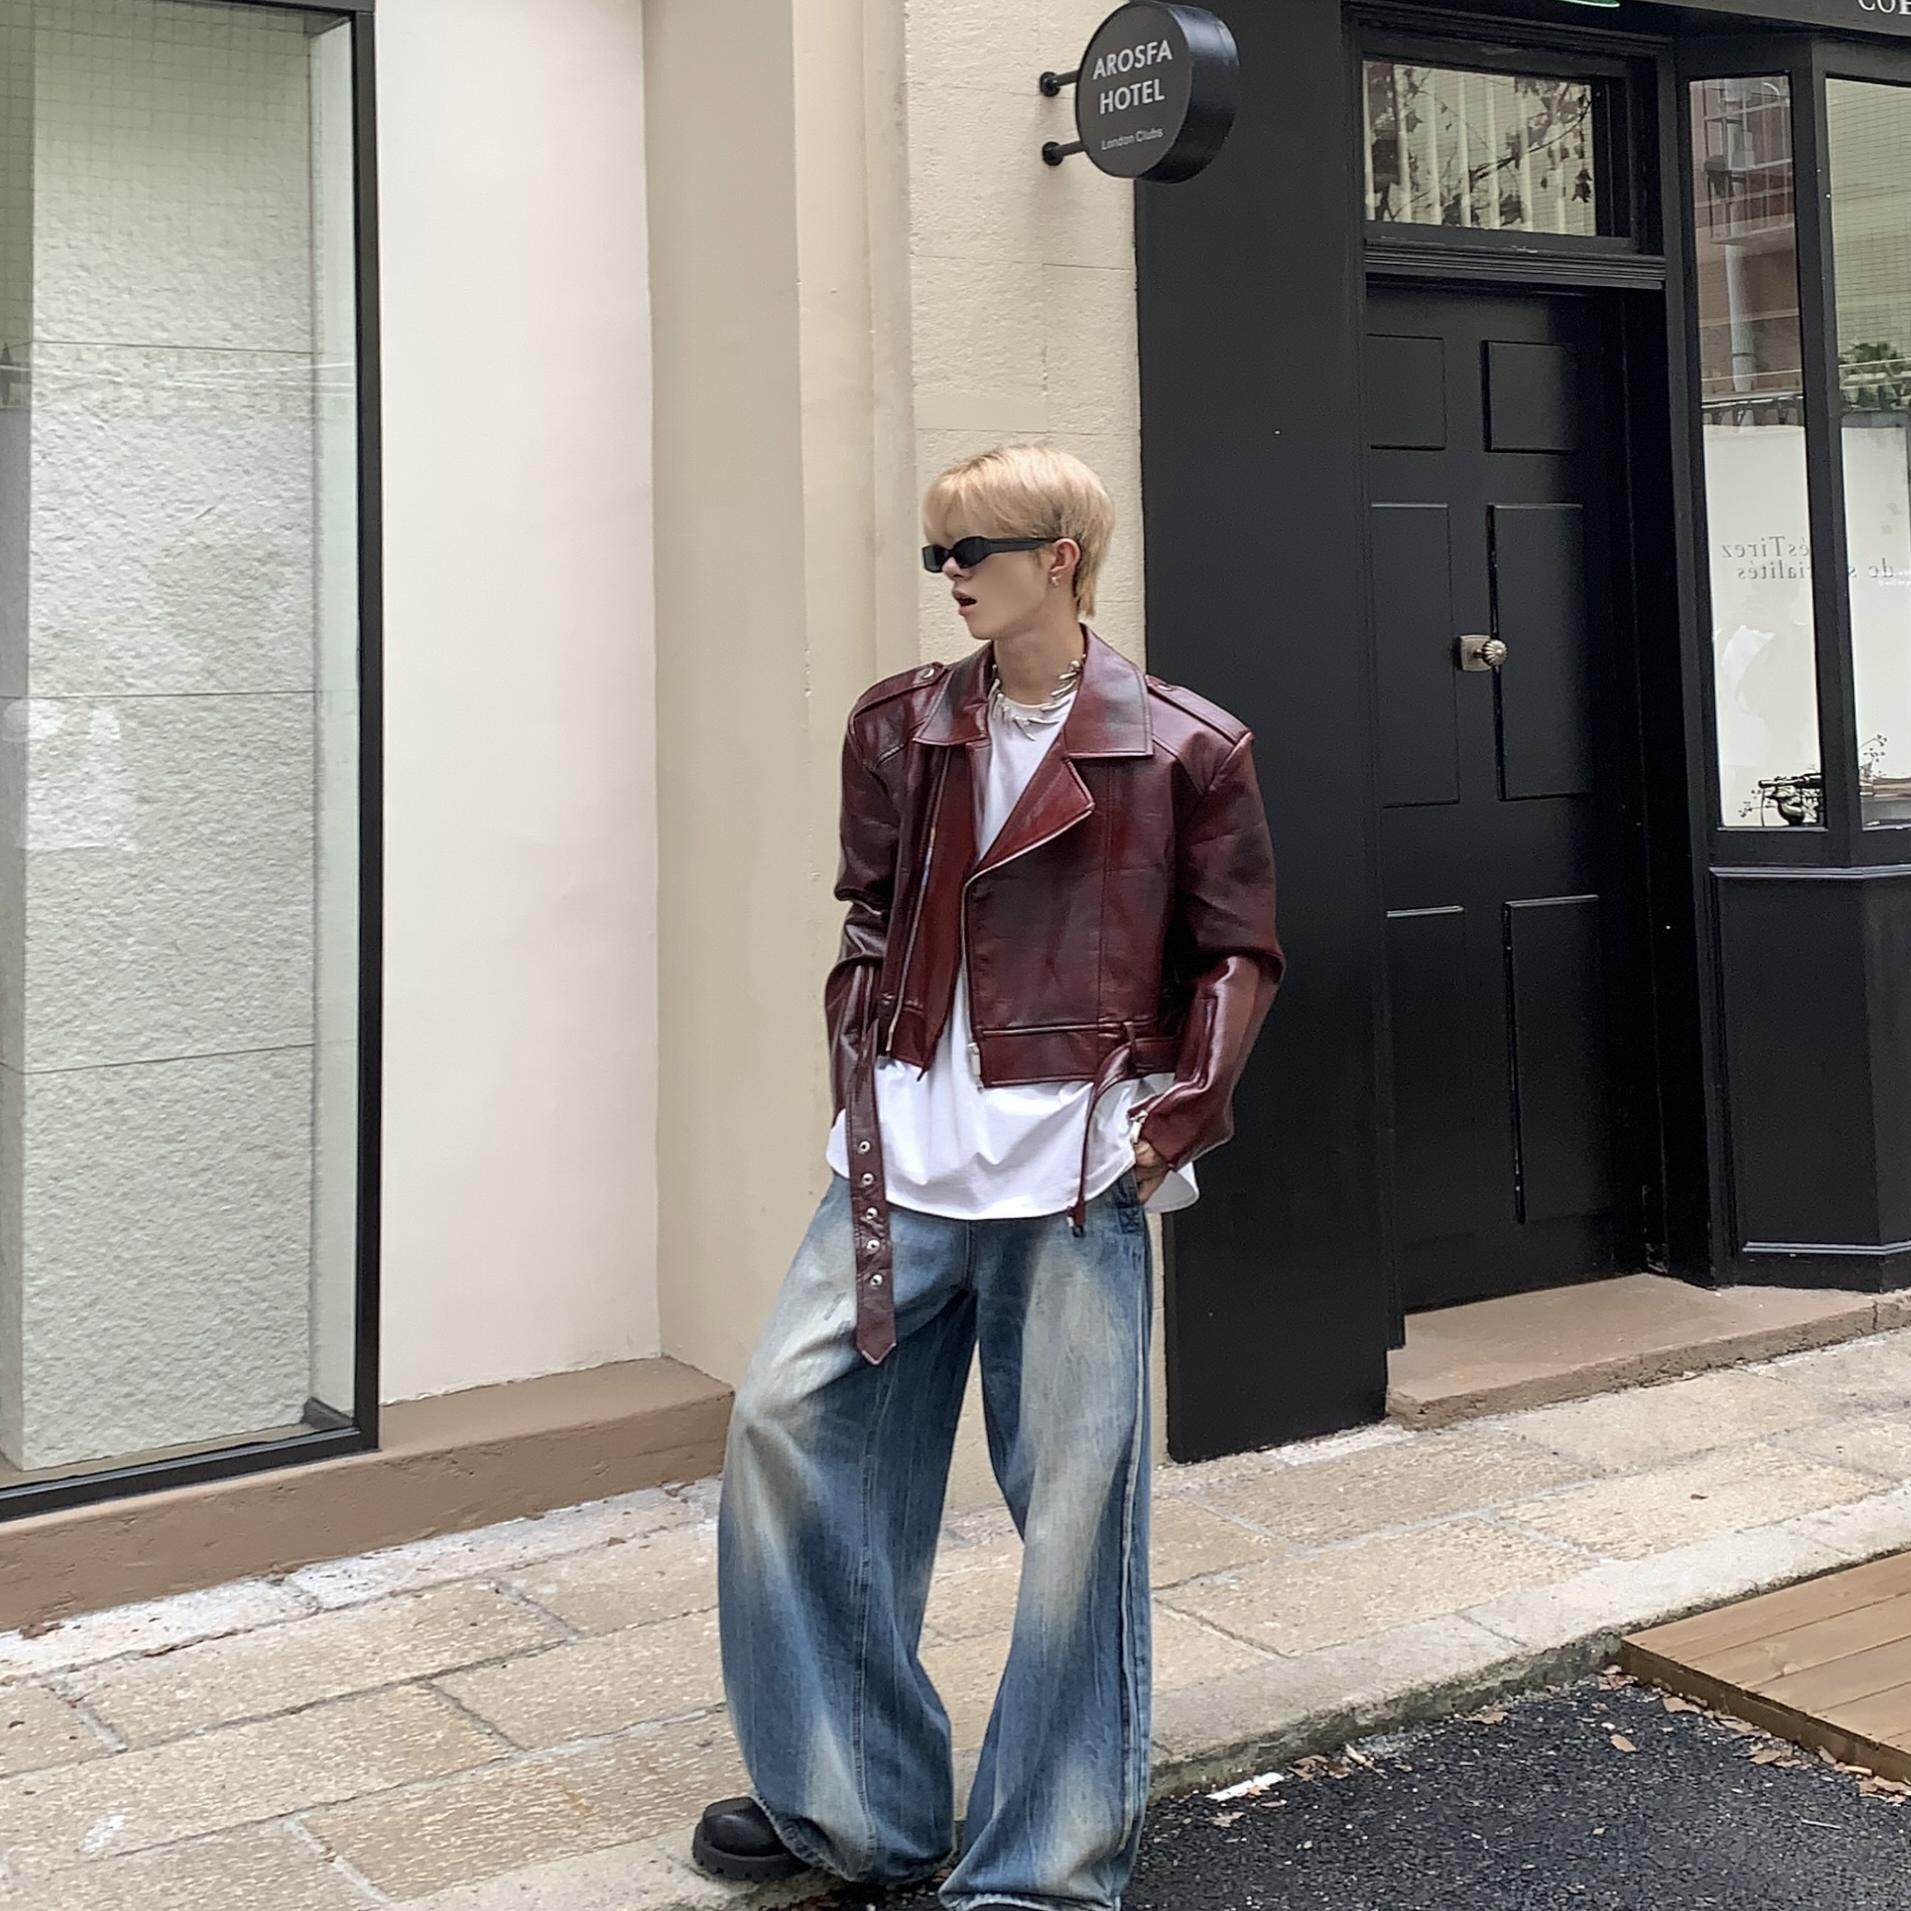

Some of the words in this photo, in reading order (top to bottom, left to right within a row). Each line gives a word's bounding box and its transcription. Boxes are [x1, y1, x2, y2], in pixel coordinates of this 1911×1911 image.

[1092, 39, 1173, 81] AROSFA
[1099, 78, 1166, 115] HOTEL
[1101, 134, 1135, 150] London
